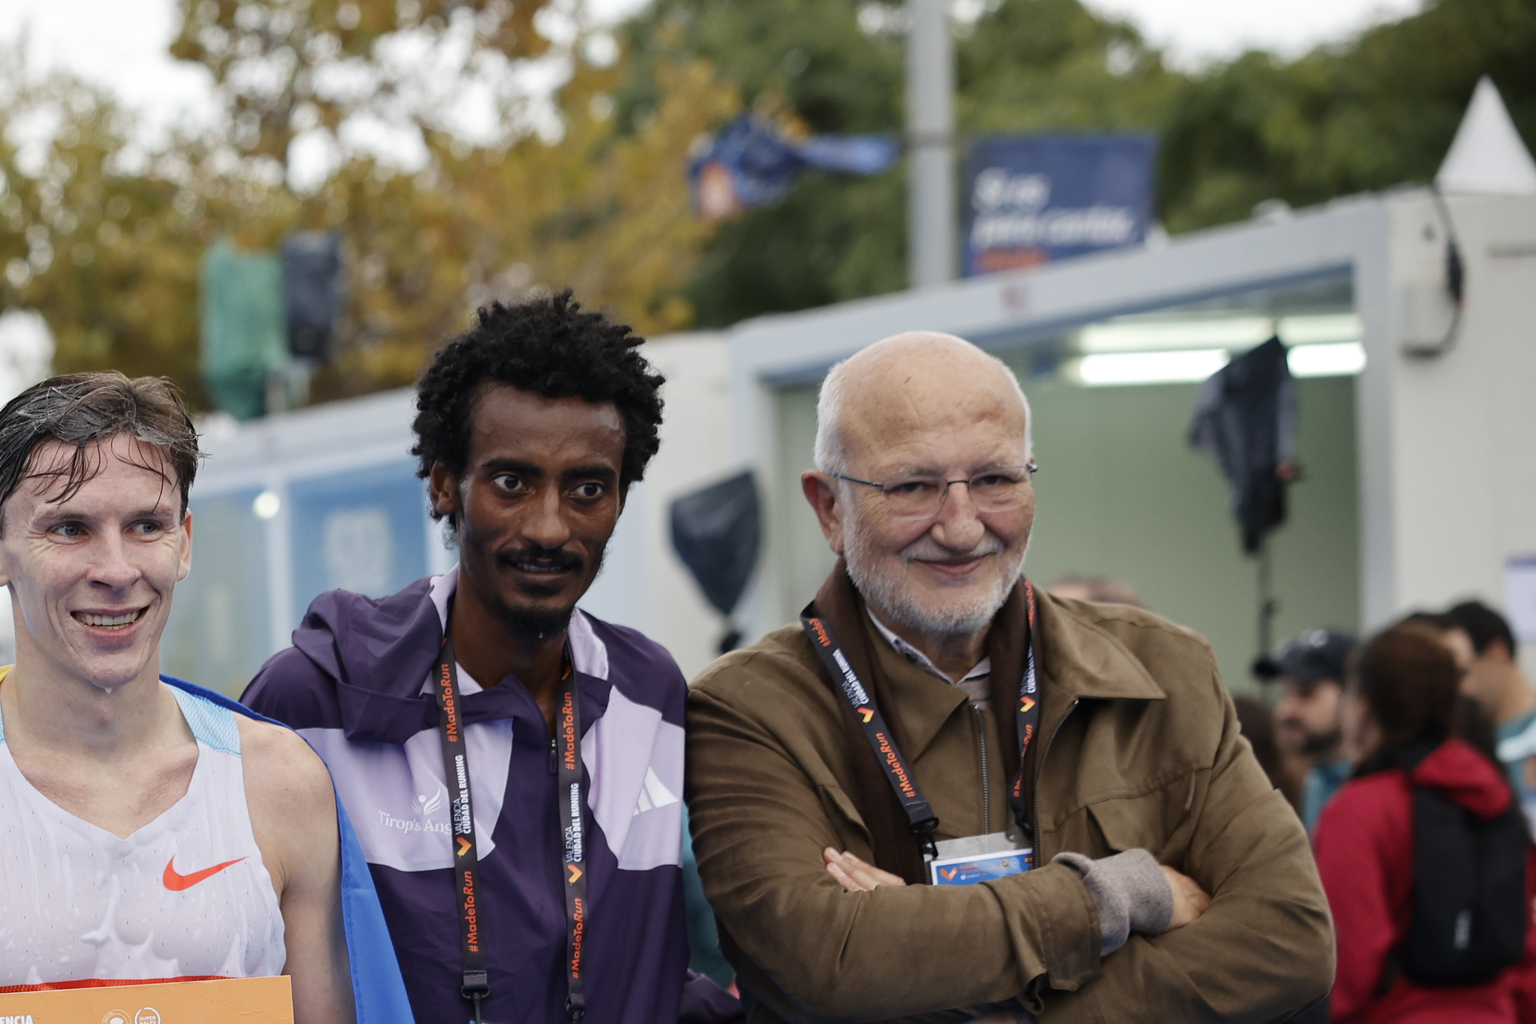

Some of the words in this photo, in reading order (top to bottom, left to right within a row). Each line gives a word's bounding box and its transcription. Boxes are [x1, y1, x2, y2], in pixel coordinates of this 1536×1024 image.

[441, 663, 458, 742] #MadeToRun
[563, 692, 576, 770] #MadeToRun
[455, 755, 467, 788] RUNNING
[876, 732, 916, 798] #MadeToRun
[461, 788, 469, 804] DEL
[570, 783, 580, 816] RUNNING
[378, 810, 421, 834] Tirop's
[453, 798, 463, 836] VALENCIA
[461, 803, 472, 835] CIUDAD
[572, 816, 581, 832] DEL
[565, 826, 574, 862] VALENCIA
[573, 832, 582, 862] CIUDAD
[463, 870, 479, 952] #MadeToRun
[571, 898, 583, 978] #MadeToRun
